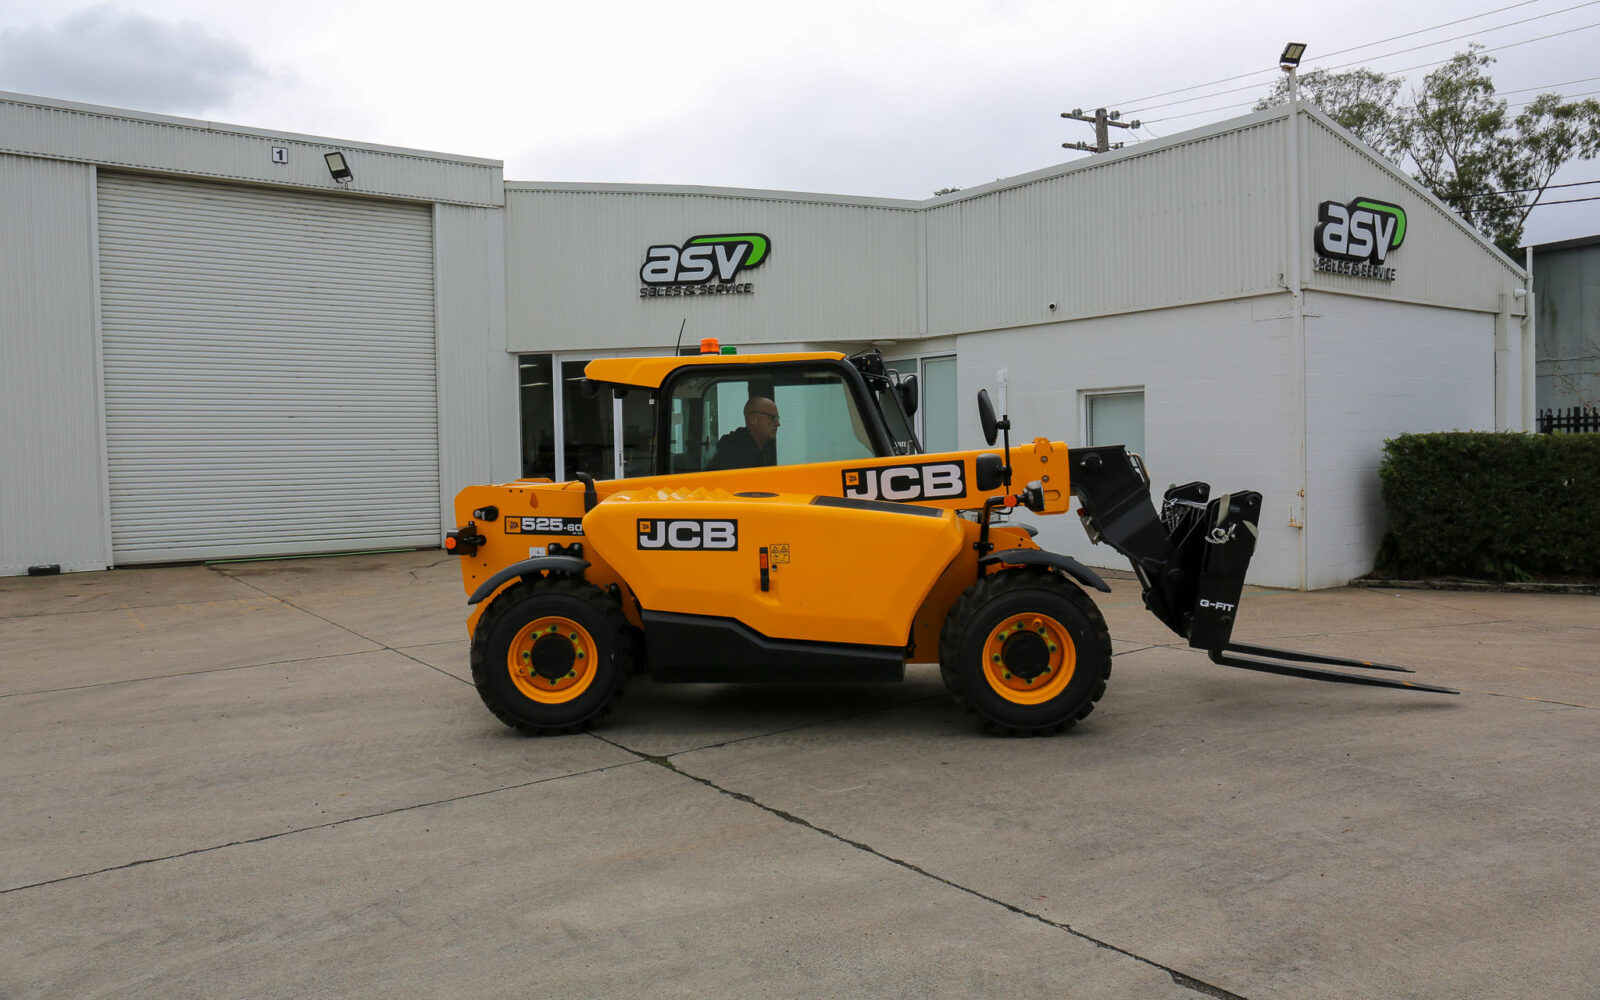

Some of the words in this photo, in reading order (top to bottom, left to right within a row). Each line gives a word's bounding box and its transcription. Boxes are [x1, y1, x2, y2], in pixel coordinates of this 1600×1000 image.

[276, 149, 284, 161] 1
[1322, 204, 1396, 261] asv
[642, 243, 749, 282] asv
[1351, 263, 1360, 276] &
[1361, 264, 1396, 281] SERVICE
[683, 285, 696, 296] &
[698, 283, 753, 296] SERVICE
[846, 463, 964, 501] JCB
[639, 520, 737, 549] JCB
[1199, 598, 1235, 612] Q-FIT
